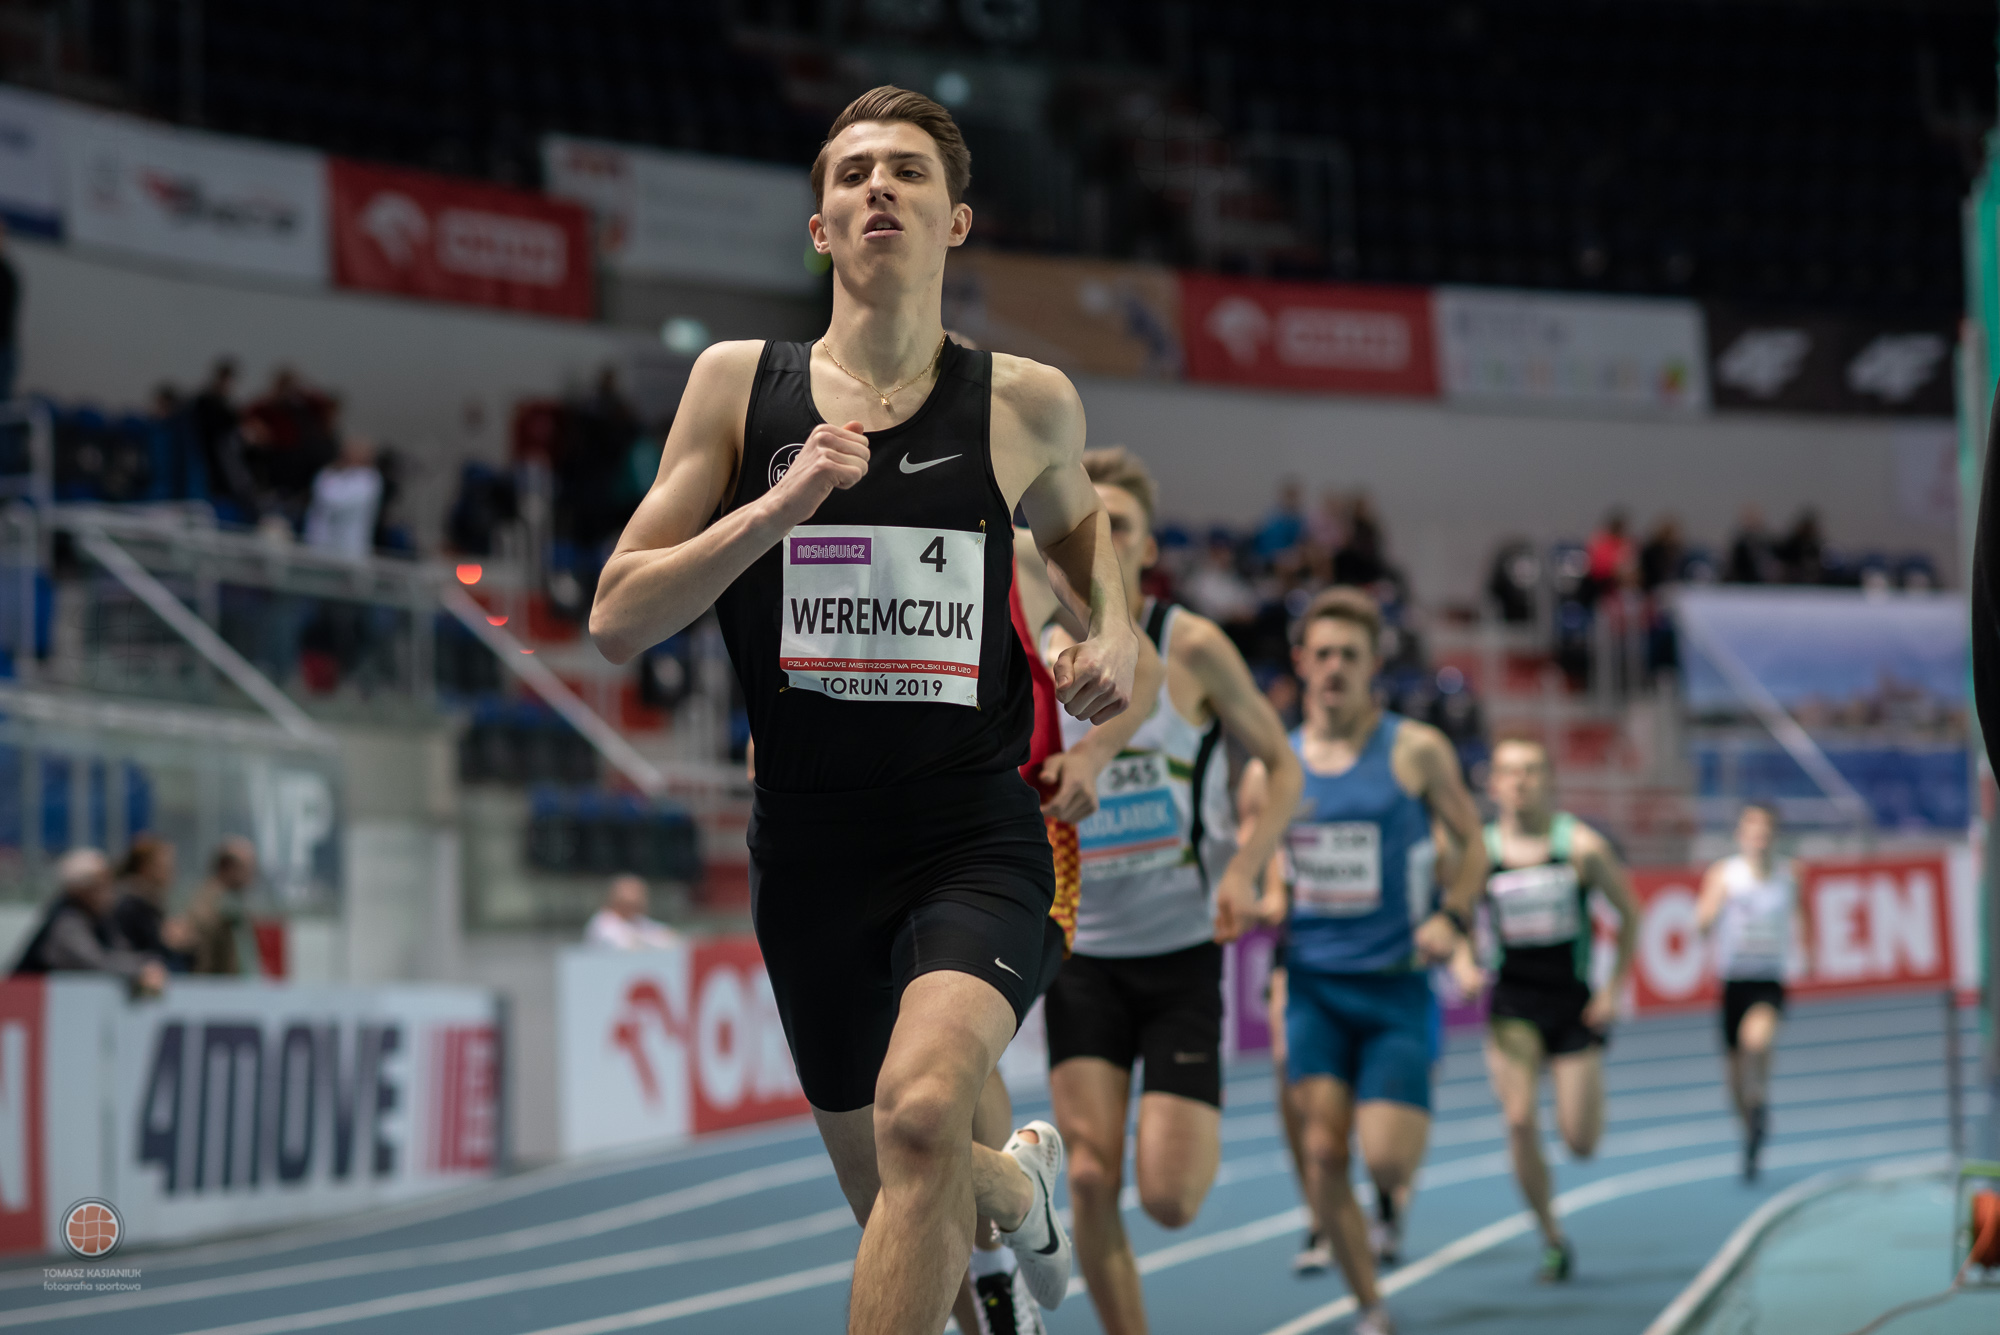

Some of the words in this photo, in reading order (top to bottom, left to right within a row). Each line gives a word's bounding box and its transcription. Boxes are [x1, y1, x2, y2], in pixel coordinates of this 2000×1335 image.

[919, 536, 947, 573] 4
[790, 597, 975, 640] WEREMCZUK
[787, 660, 810, 668] PZLA
[811, 660, 847, 669] HALOWE
[848, 662, 909, 670] MISTRZOSTWA
[910, 663, 941, 671] POLSKI
[821, 674, 888, 697] TORUŃ
[895, 679, 943, 697] 2019
[1639, 868, 1942, 1000] OEN
[136, 1022, 402, 1194] 4MOVE
